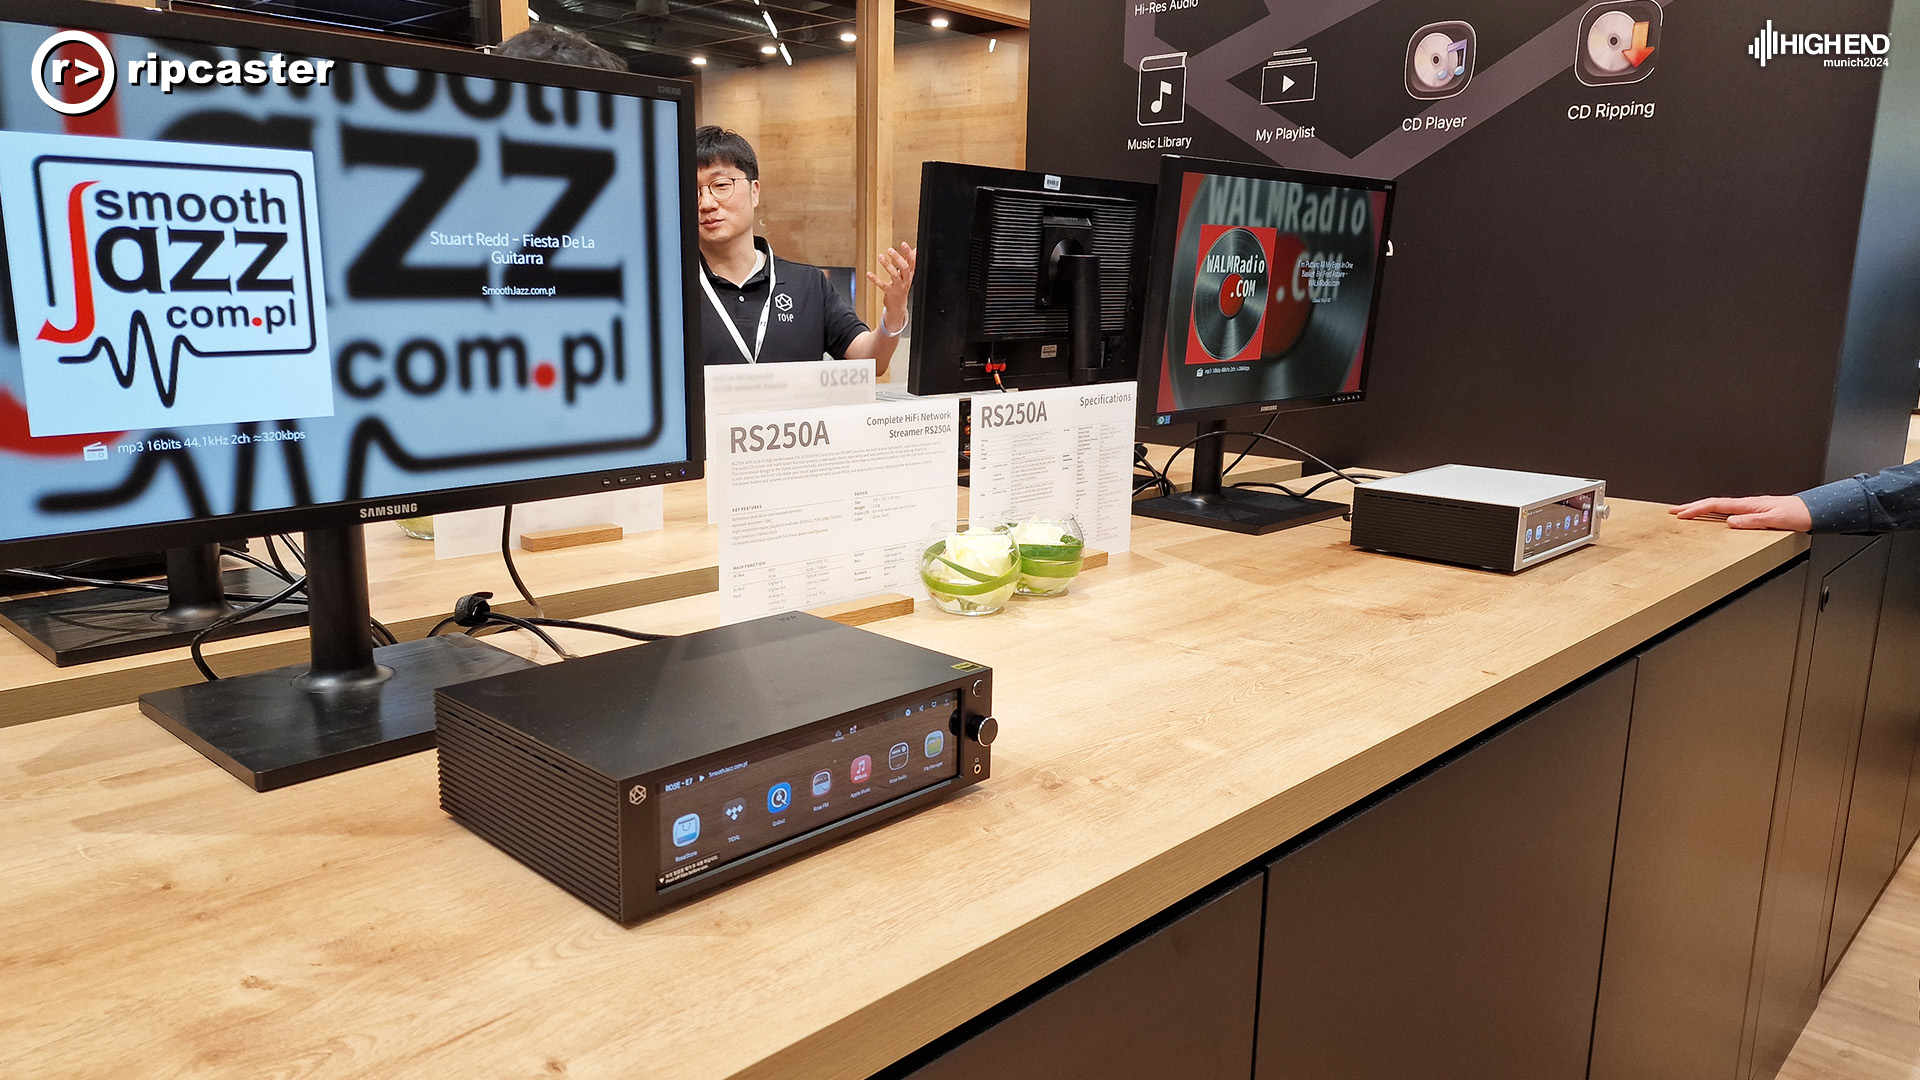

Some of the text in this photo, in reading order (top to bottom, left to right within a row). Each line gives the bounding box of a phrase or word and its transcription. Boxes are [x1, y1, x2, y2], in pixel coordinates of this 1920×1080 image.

[1134, 0, 1199, 16] Hi-Res Audio
[1567, 100, 1656, 121] CD Ripping
[1402, 115, 1468, 132] CD Player
[1127, 136, 1193, 150] Music Library
[1255, 125, 1316, 144] My Playlist
[94, 188, 287, 225] smooth
[430, 231, 474, 247] Stuart
[476, 232, 510, 247] Redd
[522, 234, 560, 248] Fiesta
[562, 235, 579, 248] De
[581, 236, 596, 249] La
[491, 251, 544, 265] Guitarra
[1206, 254, 1266, 274] WALMRadio
[481, 285, 556, 298] SmoothJazz.com.pl
[1230, 279, 1256, 298] .COM
[166, 298, 297, 334] com.pl
[777, 312, 795, 323] rose
[334, 314, 627, 406] com.pl
[866, 410, 952, 427] Complete HiFi Network
[981, 392, 1132, 429] RS250A Specifications
[729, 419, 831, 455] RS250A
[889, 424, 952, 439] Streamer RS250A
[117, 440, 144, 455] mp3
[146, 438, 182, 452] 16bits
[183, 435, 229, 449] 44.1kHz
[230, 432, 251, 445] 2ch
[359, 502, 419, 519] SAMSUNG
[665, 781, 681, 792] ROSE
[850, 786, 871, 799] Apple Music
[728, 834, 741, 843] TIDAL
